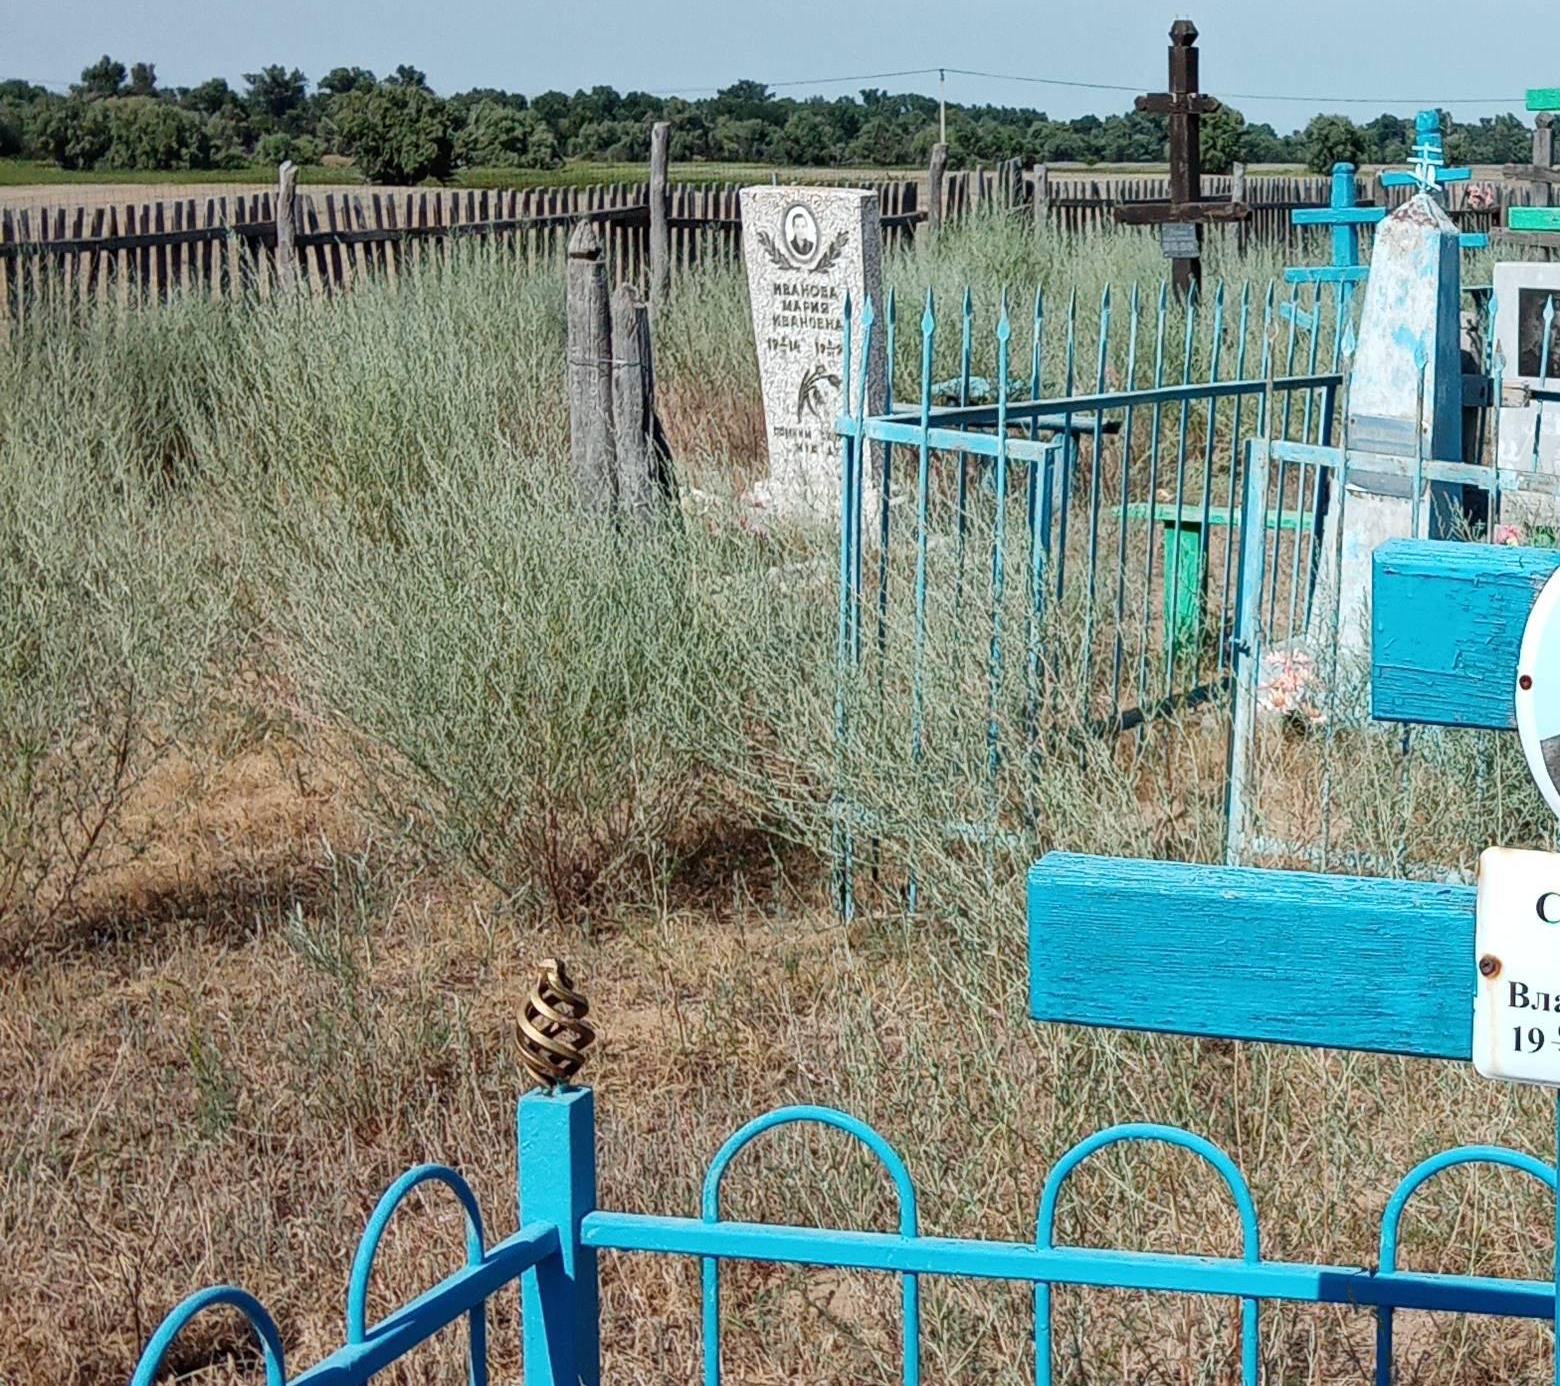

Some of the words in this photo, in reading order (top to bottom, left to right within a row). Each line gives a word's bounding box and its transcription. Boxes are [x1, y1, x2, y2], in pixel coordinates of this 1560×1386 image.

[773, 283, 838, 300] ИВАНОВА
[782, 299, 829, 314] МАРИЯ
[1512, 1025, 1545, 1054] 19
